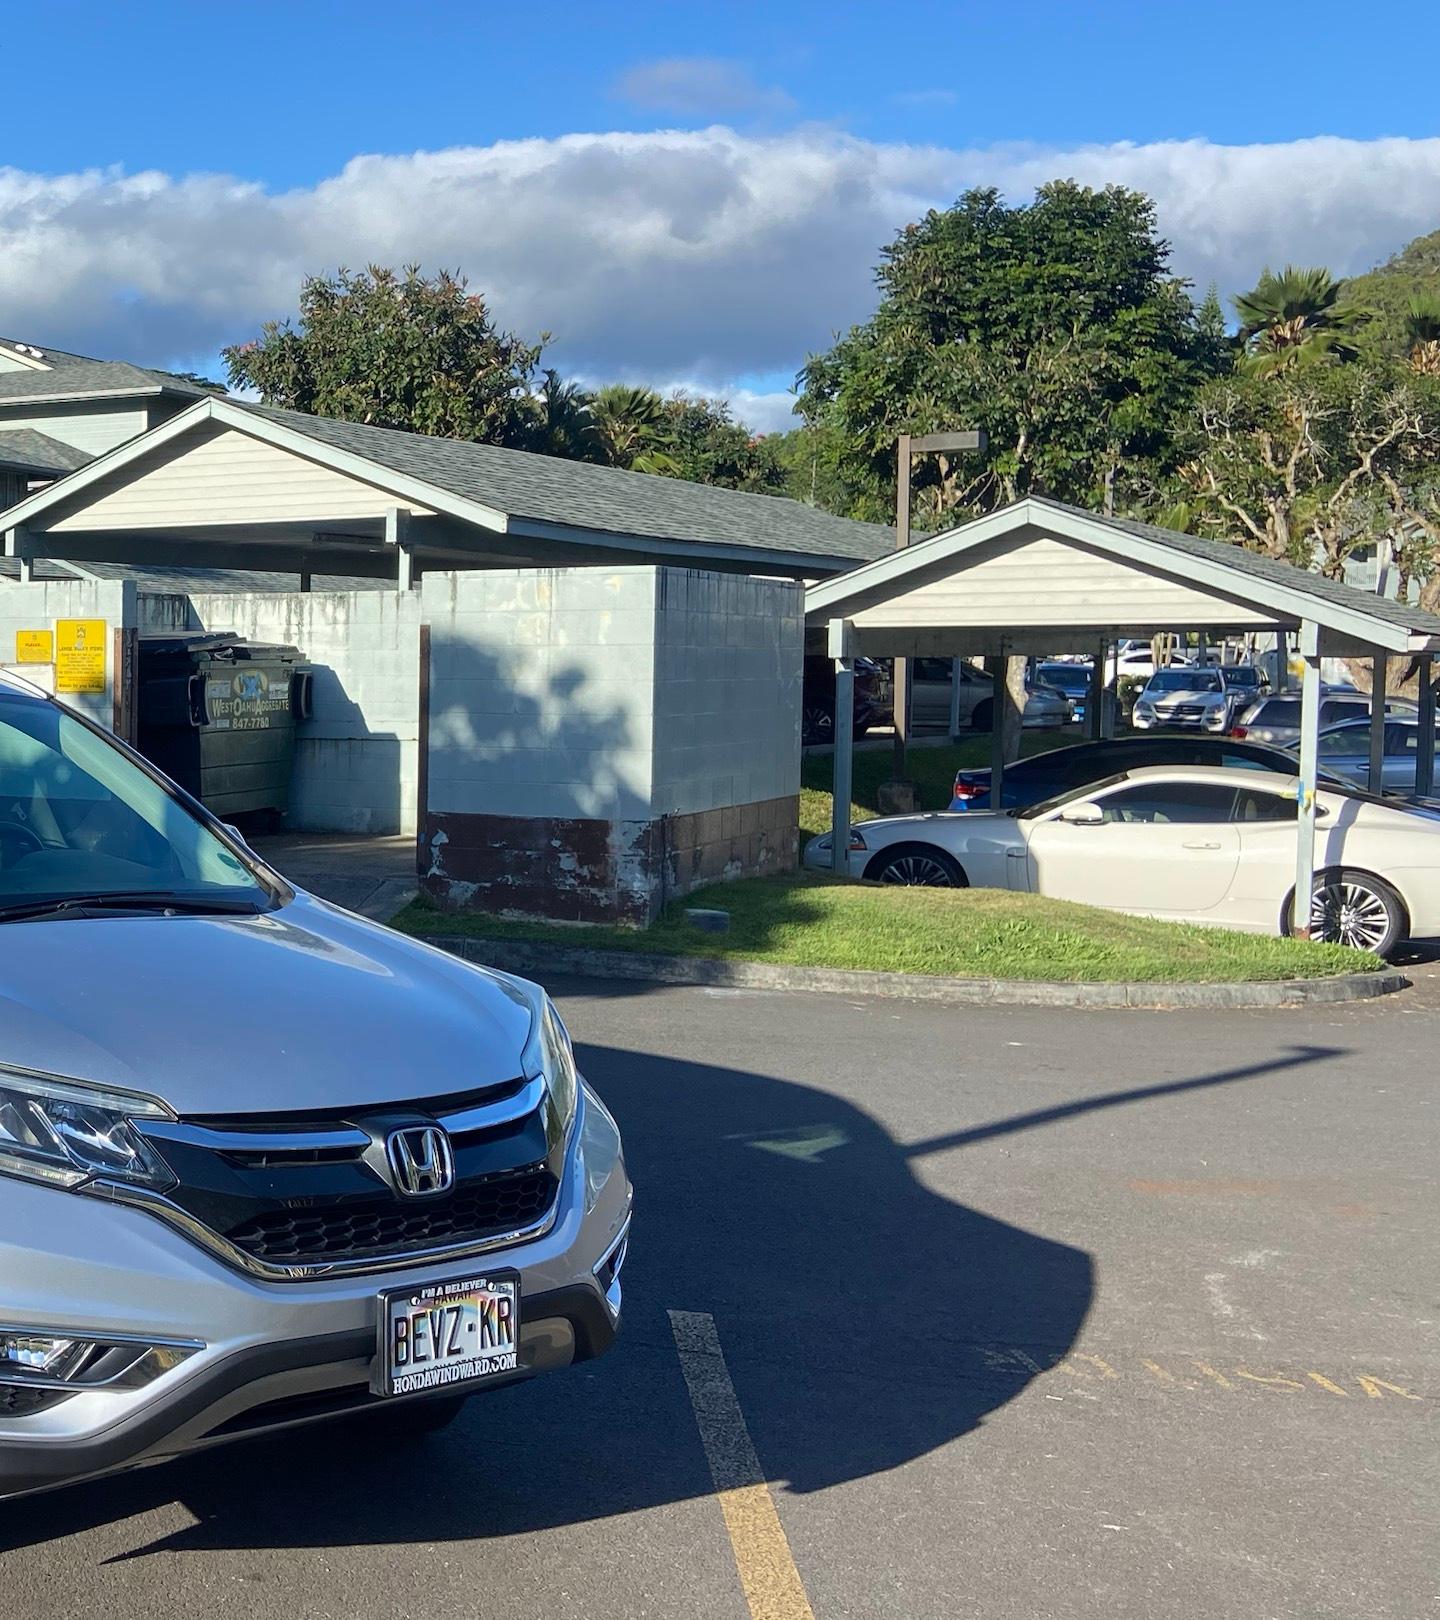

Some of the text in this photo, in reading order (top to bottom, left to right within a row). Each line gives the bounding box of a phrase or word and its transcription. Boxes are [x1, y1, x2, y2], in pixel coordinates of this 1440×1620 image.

[212, 699, 234, 717] WEST
[234, 698, 256, 716] OAHU
[421, 1288, 436, 1299] I'M
[436, 1286, 444, 1297] A
[445, 1279, 487, 1295] BELIEVER
[392, 1353, 518, 1394] HONDAWINDWARD.COM
